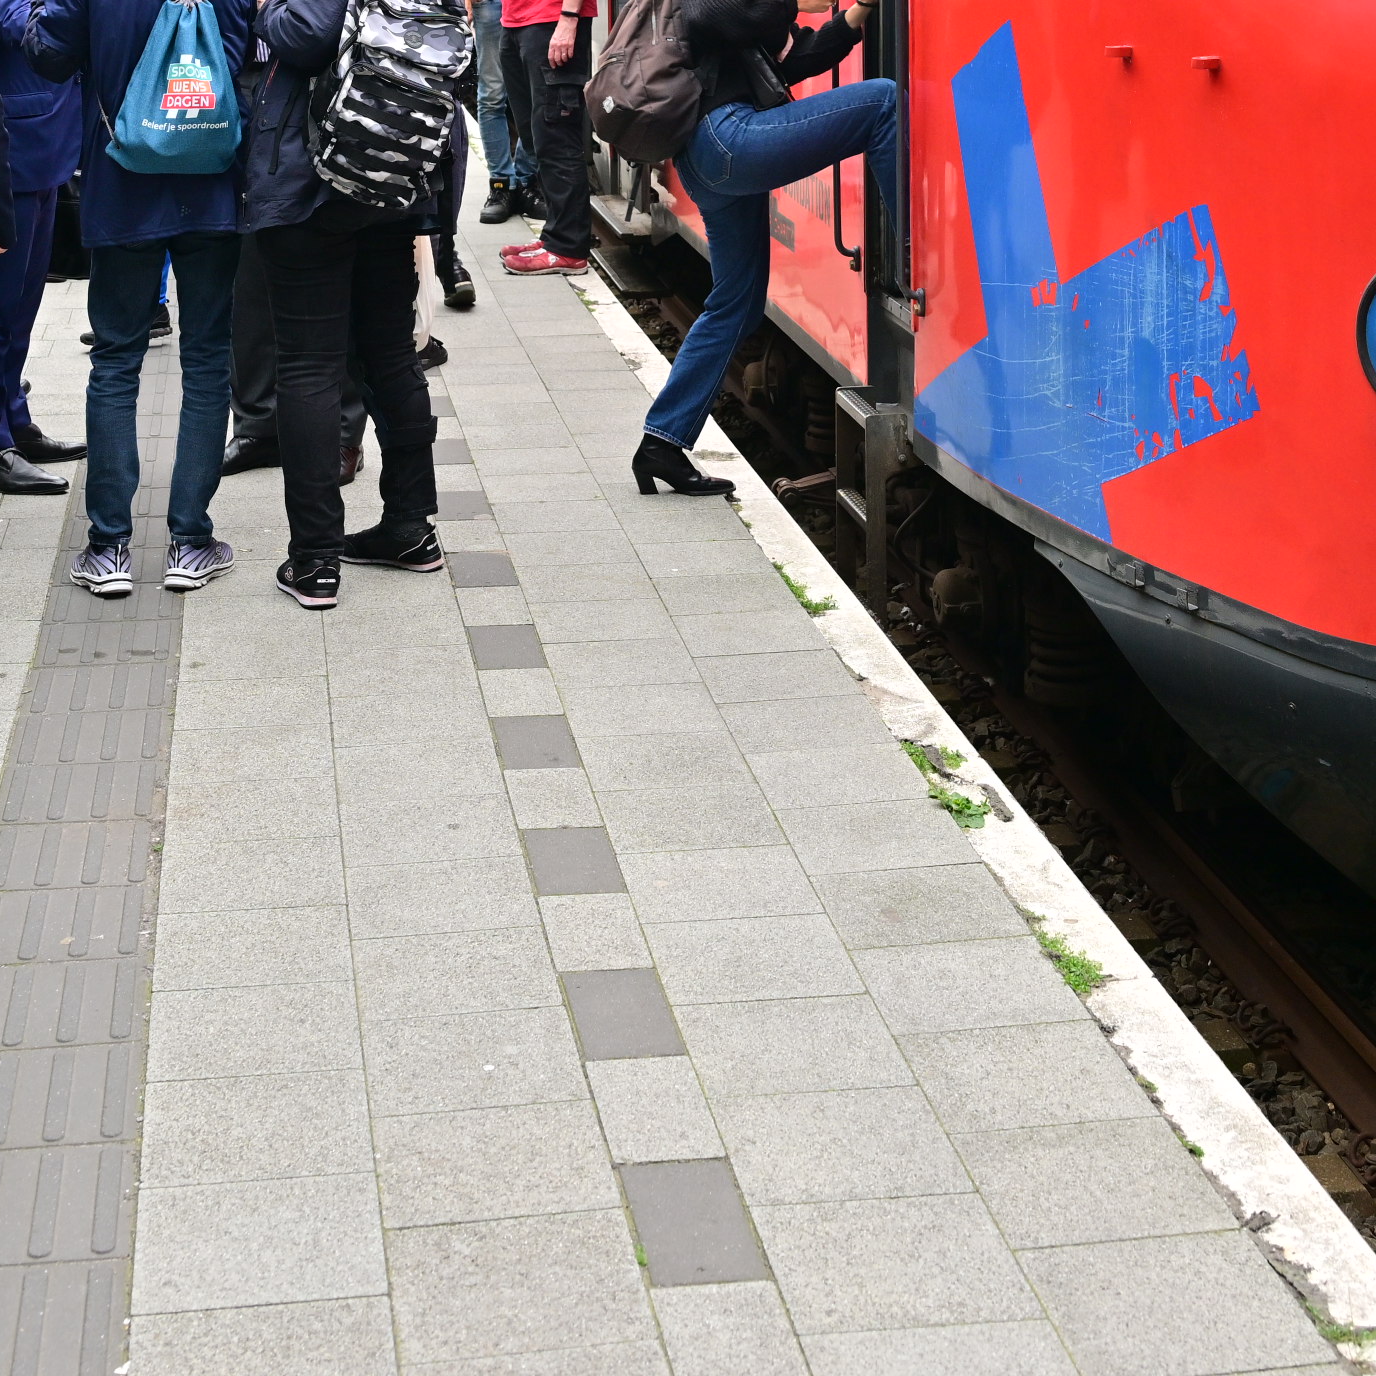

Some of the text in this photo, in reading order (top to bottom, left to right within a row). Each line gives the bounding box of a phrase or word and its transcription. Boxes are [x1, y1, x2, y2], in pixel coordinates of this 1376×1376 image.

[171, 66, 208, 78] SPOOR
[172, 81, 207, 92] WENS
[166, 96, 210, 107] DAGEN
[141, 119, 229, 132] Beleef je spoordroom!
